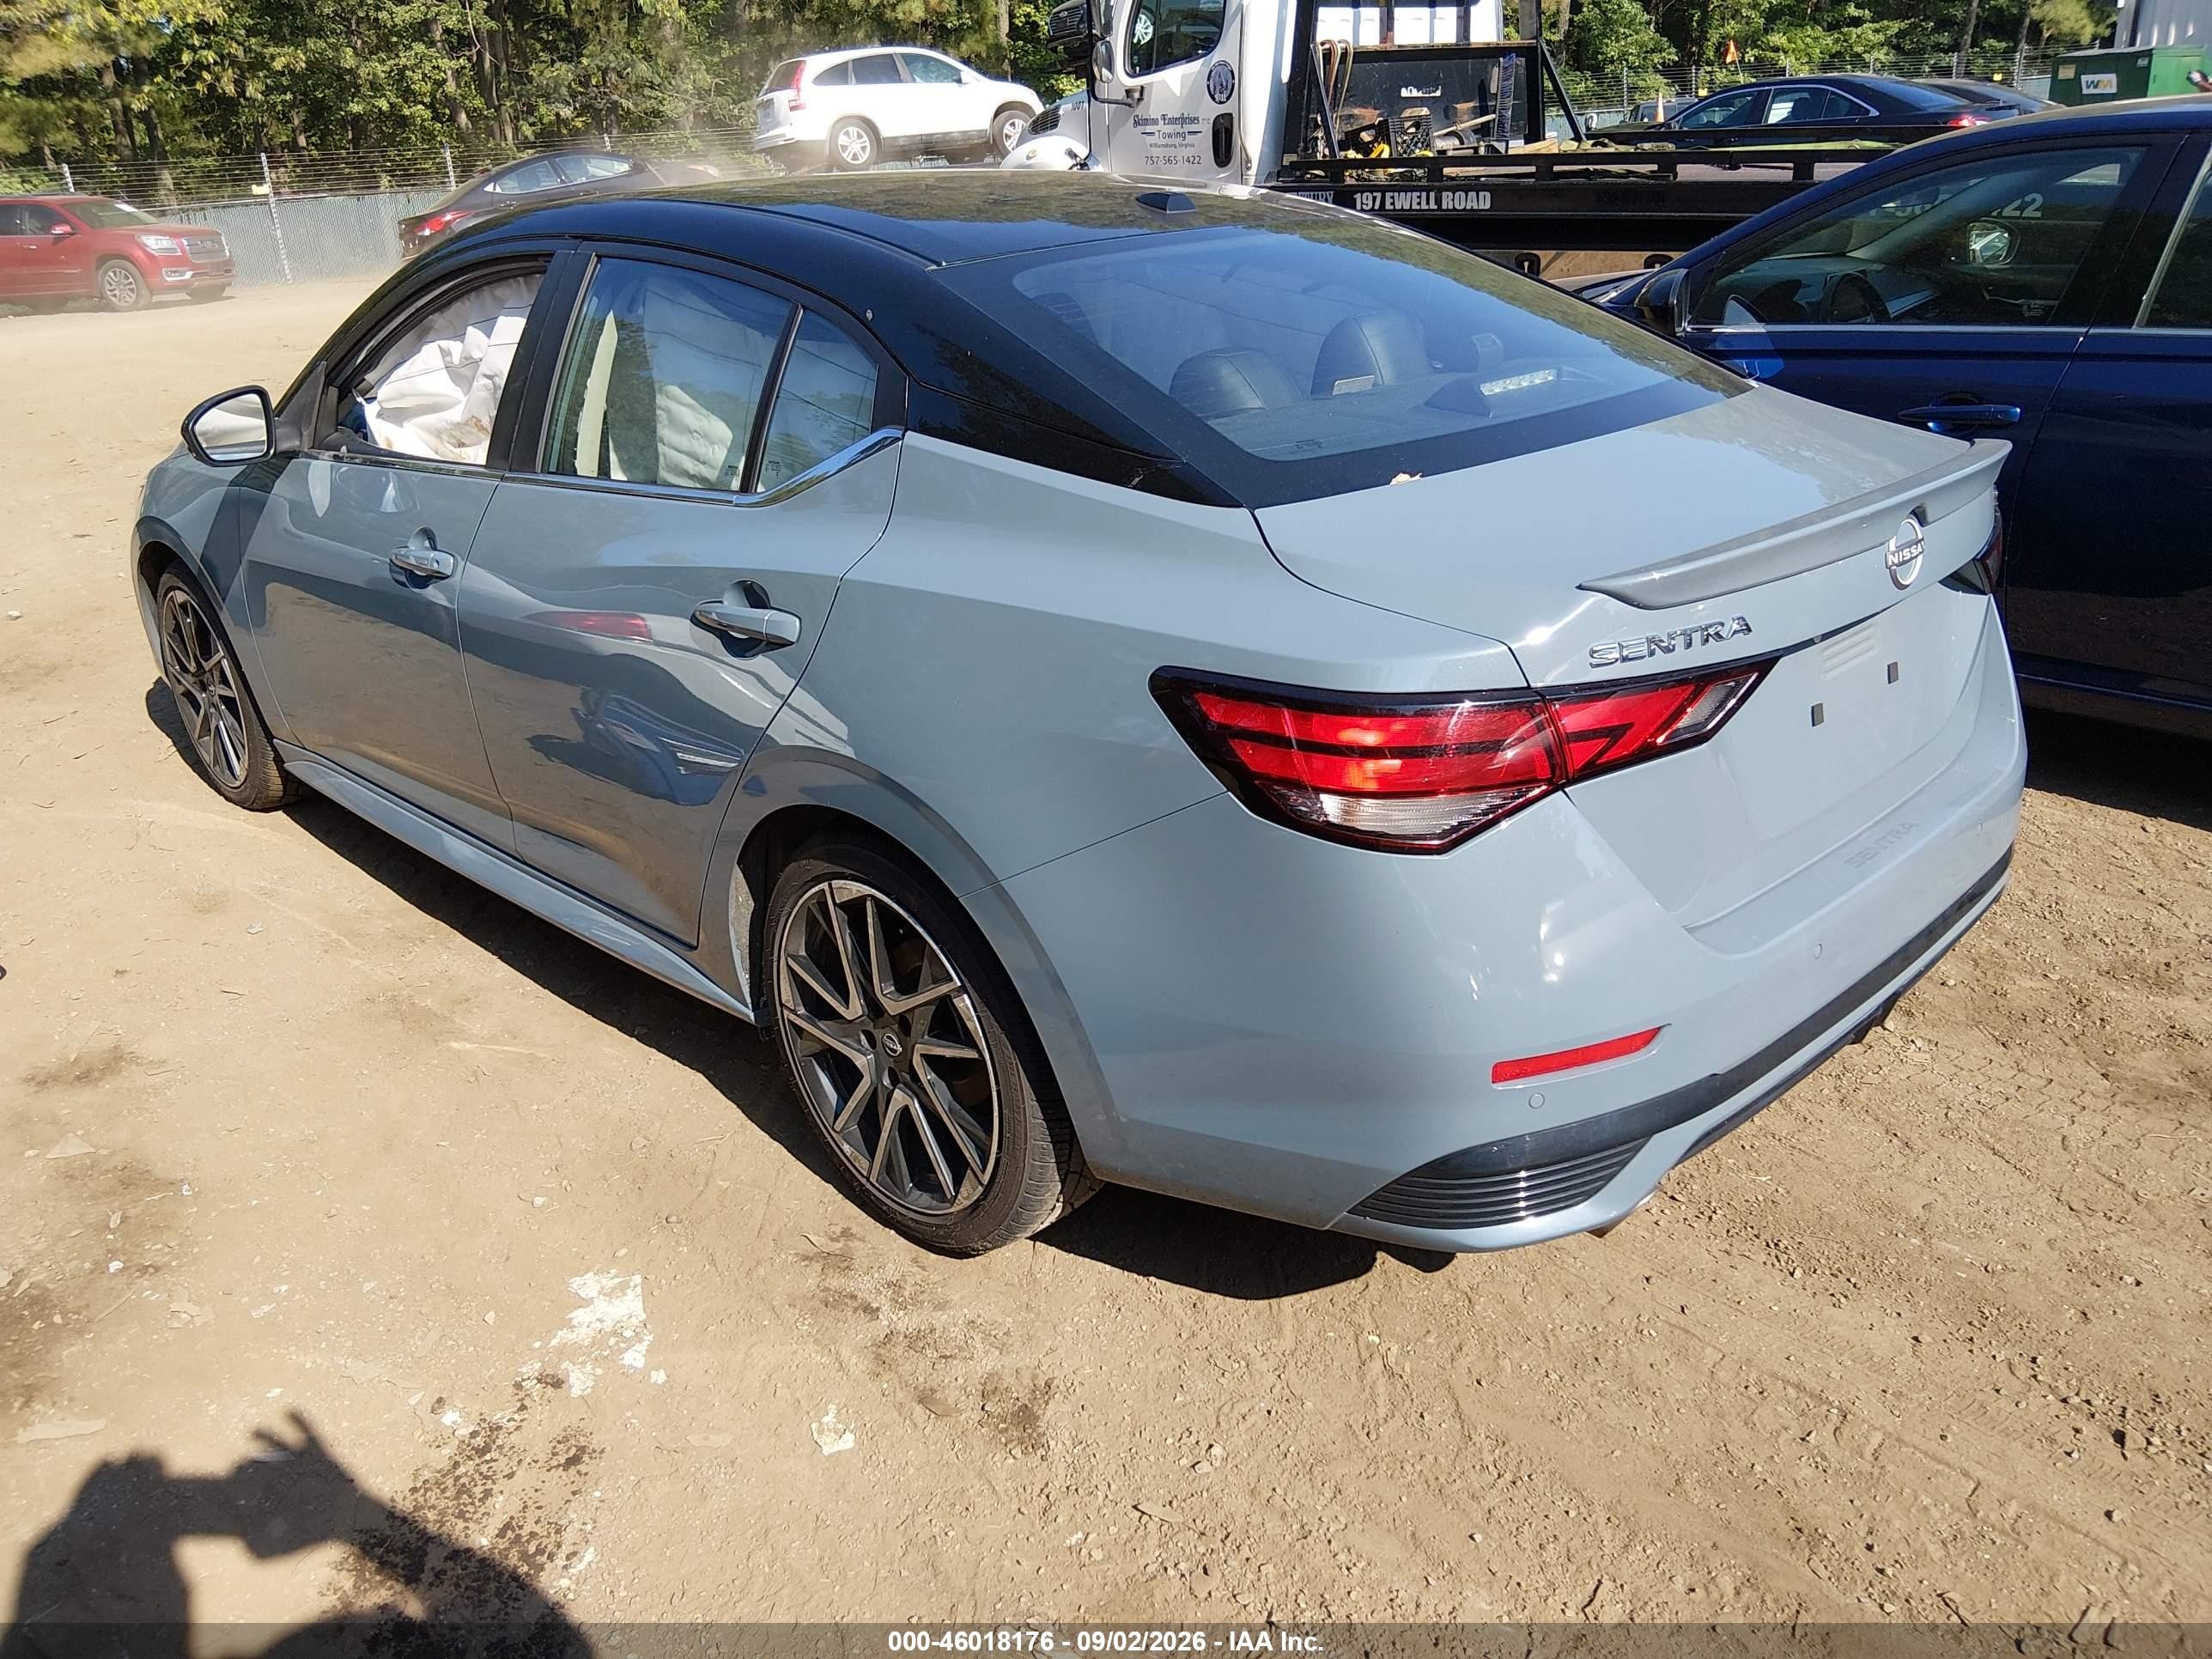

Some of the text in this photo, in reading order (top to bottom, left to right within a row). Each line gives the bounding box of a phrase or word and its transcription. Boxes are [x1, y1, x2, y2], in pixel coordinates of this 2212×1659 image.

[2085, 79, 2113, 89] WM
[1133, 114, 1159, 128] Skimino
[1160, 112, 1200, 128] Enterprises
[1156, 130, 1187, 141] Towing
[1144, 155, 1202, 166] 757-565-1422
[1353, 191, 1492, 210] 197 EWELL ROAD
[1589, 615, 1753, 669] SENTRA
